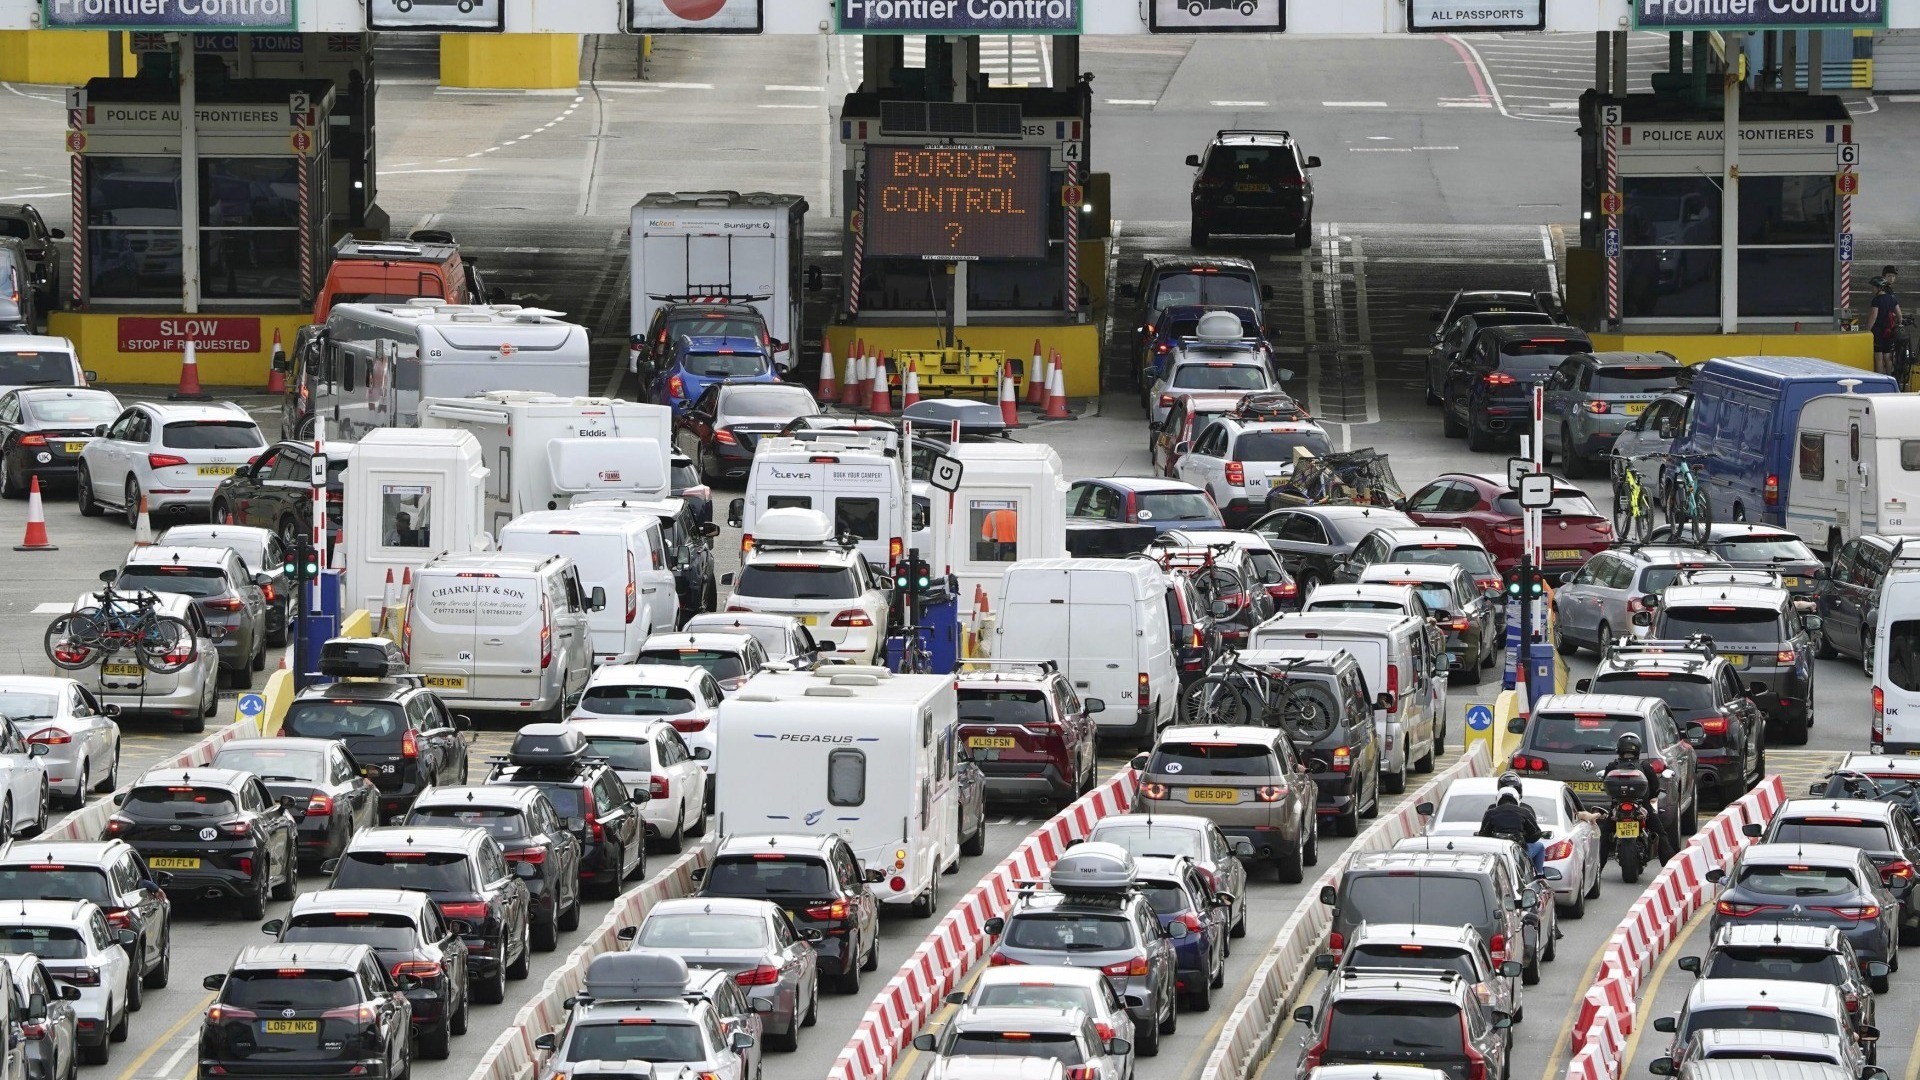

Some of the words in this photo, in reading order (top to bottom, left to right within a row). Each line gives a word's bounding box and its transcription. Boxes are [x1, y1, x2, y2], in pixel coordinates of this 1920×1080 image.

[55, 0, 166, 15] Frontier
[179, 0, 286, 15] Control
[847, 0, 958, 19] Frontier
[966, 0, 1071, 19] Control
[1644, 0, 1757, 14] Frontier
[1768, 0, 1878, 14] Control
[1431, 11, 1452, 20] ALL
[1456, 9, 1524, 20] PASSPORTS
[195, 36, 217, 49] UK
[72, 91, 80, 107] 1
[294, 95, 305, 112] 2
[107, 110, 157, 121] POLICE
[162, 110, 180, 121] AU
[1606, 106, 1617, 122] 5
[1642, 130, 1692, 141] POLICE
[1696, 130, 1723, 140] AUX
[1738, 129, 1814, 140] RONTIERES
[1066, 144, 1078, 159] 4
[1843, 146, 1854, 162] 6
[893, 151, 1017, 179] BORDER
[881, 186, 1026, 214] CONTROL
[724, 222, 762, 230] Sunlight
[944, 222, 963, 248] ?
[160, 320, 218, 336] SLOW
[128, 340, 160, 350] STOP
[163, 340, 174, 350] IF
[177, 340, 250, 350] RQUESTED
[430, 349, 442, 357] GB
[579, 429, 607, 437] Elddis
[39, 453, 50, 461] UK
[939, 465, 954, 481] G
[432, 585, 491, 598] CHARNLEY
[492, 586, 500, 594] &
[502, 588, 525, 599] SON
[104, 665, 125, 673] RJ64
[447, 677, 462, 687] YRN
[1121, 691, 1133, 699] UK
[780, 734, 854, 743] PEGASUS
[974, 738, 992, 747] KL19
[994, 738, 1010, 747] FSN
[1167, 763, 1179, 771] UK
[201, 831, 215, 839] UK
[176, 858, 195, 867] FLW
[267, 1021, 292, 1031] LO67
[295, 1021, 314, 1031] NKG
